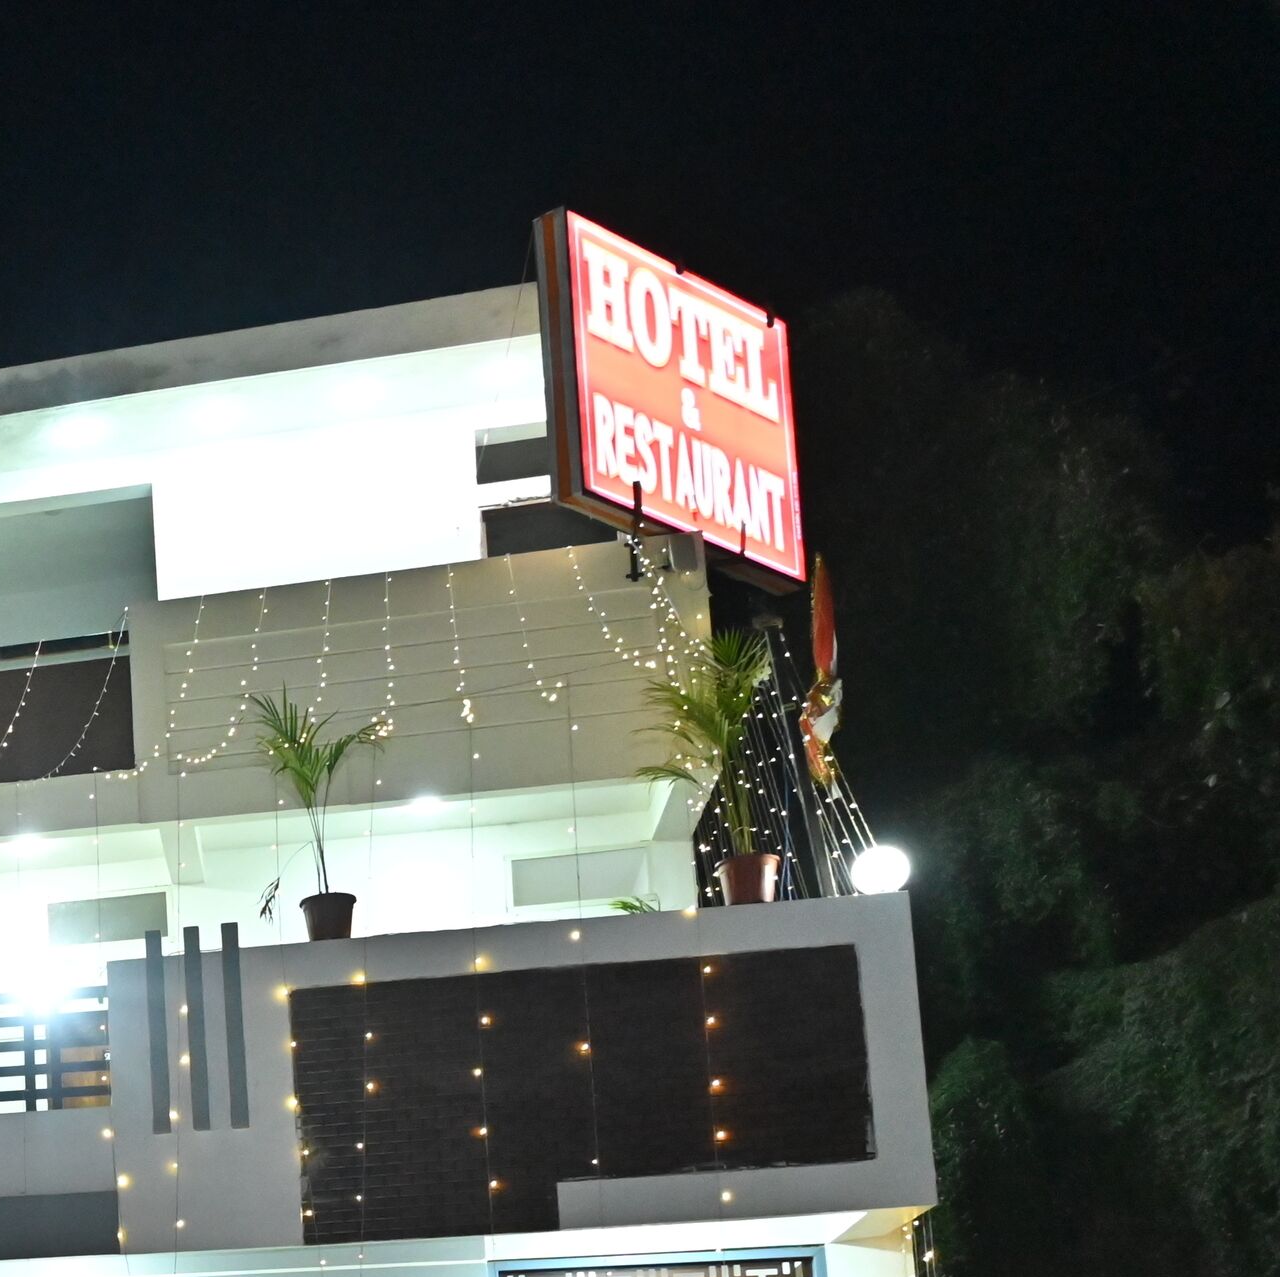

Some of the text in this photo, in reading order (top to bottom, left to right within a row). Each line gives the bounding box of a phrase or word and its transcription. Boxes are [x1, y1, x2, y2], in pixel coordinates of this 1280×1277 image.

[582, 239, 780, 423] HOTEL
[681, 387, 702, 432] &
[592, 391, 785, 553] RESTAURANT
